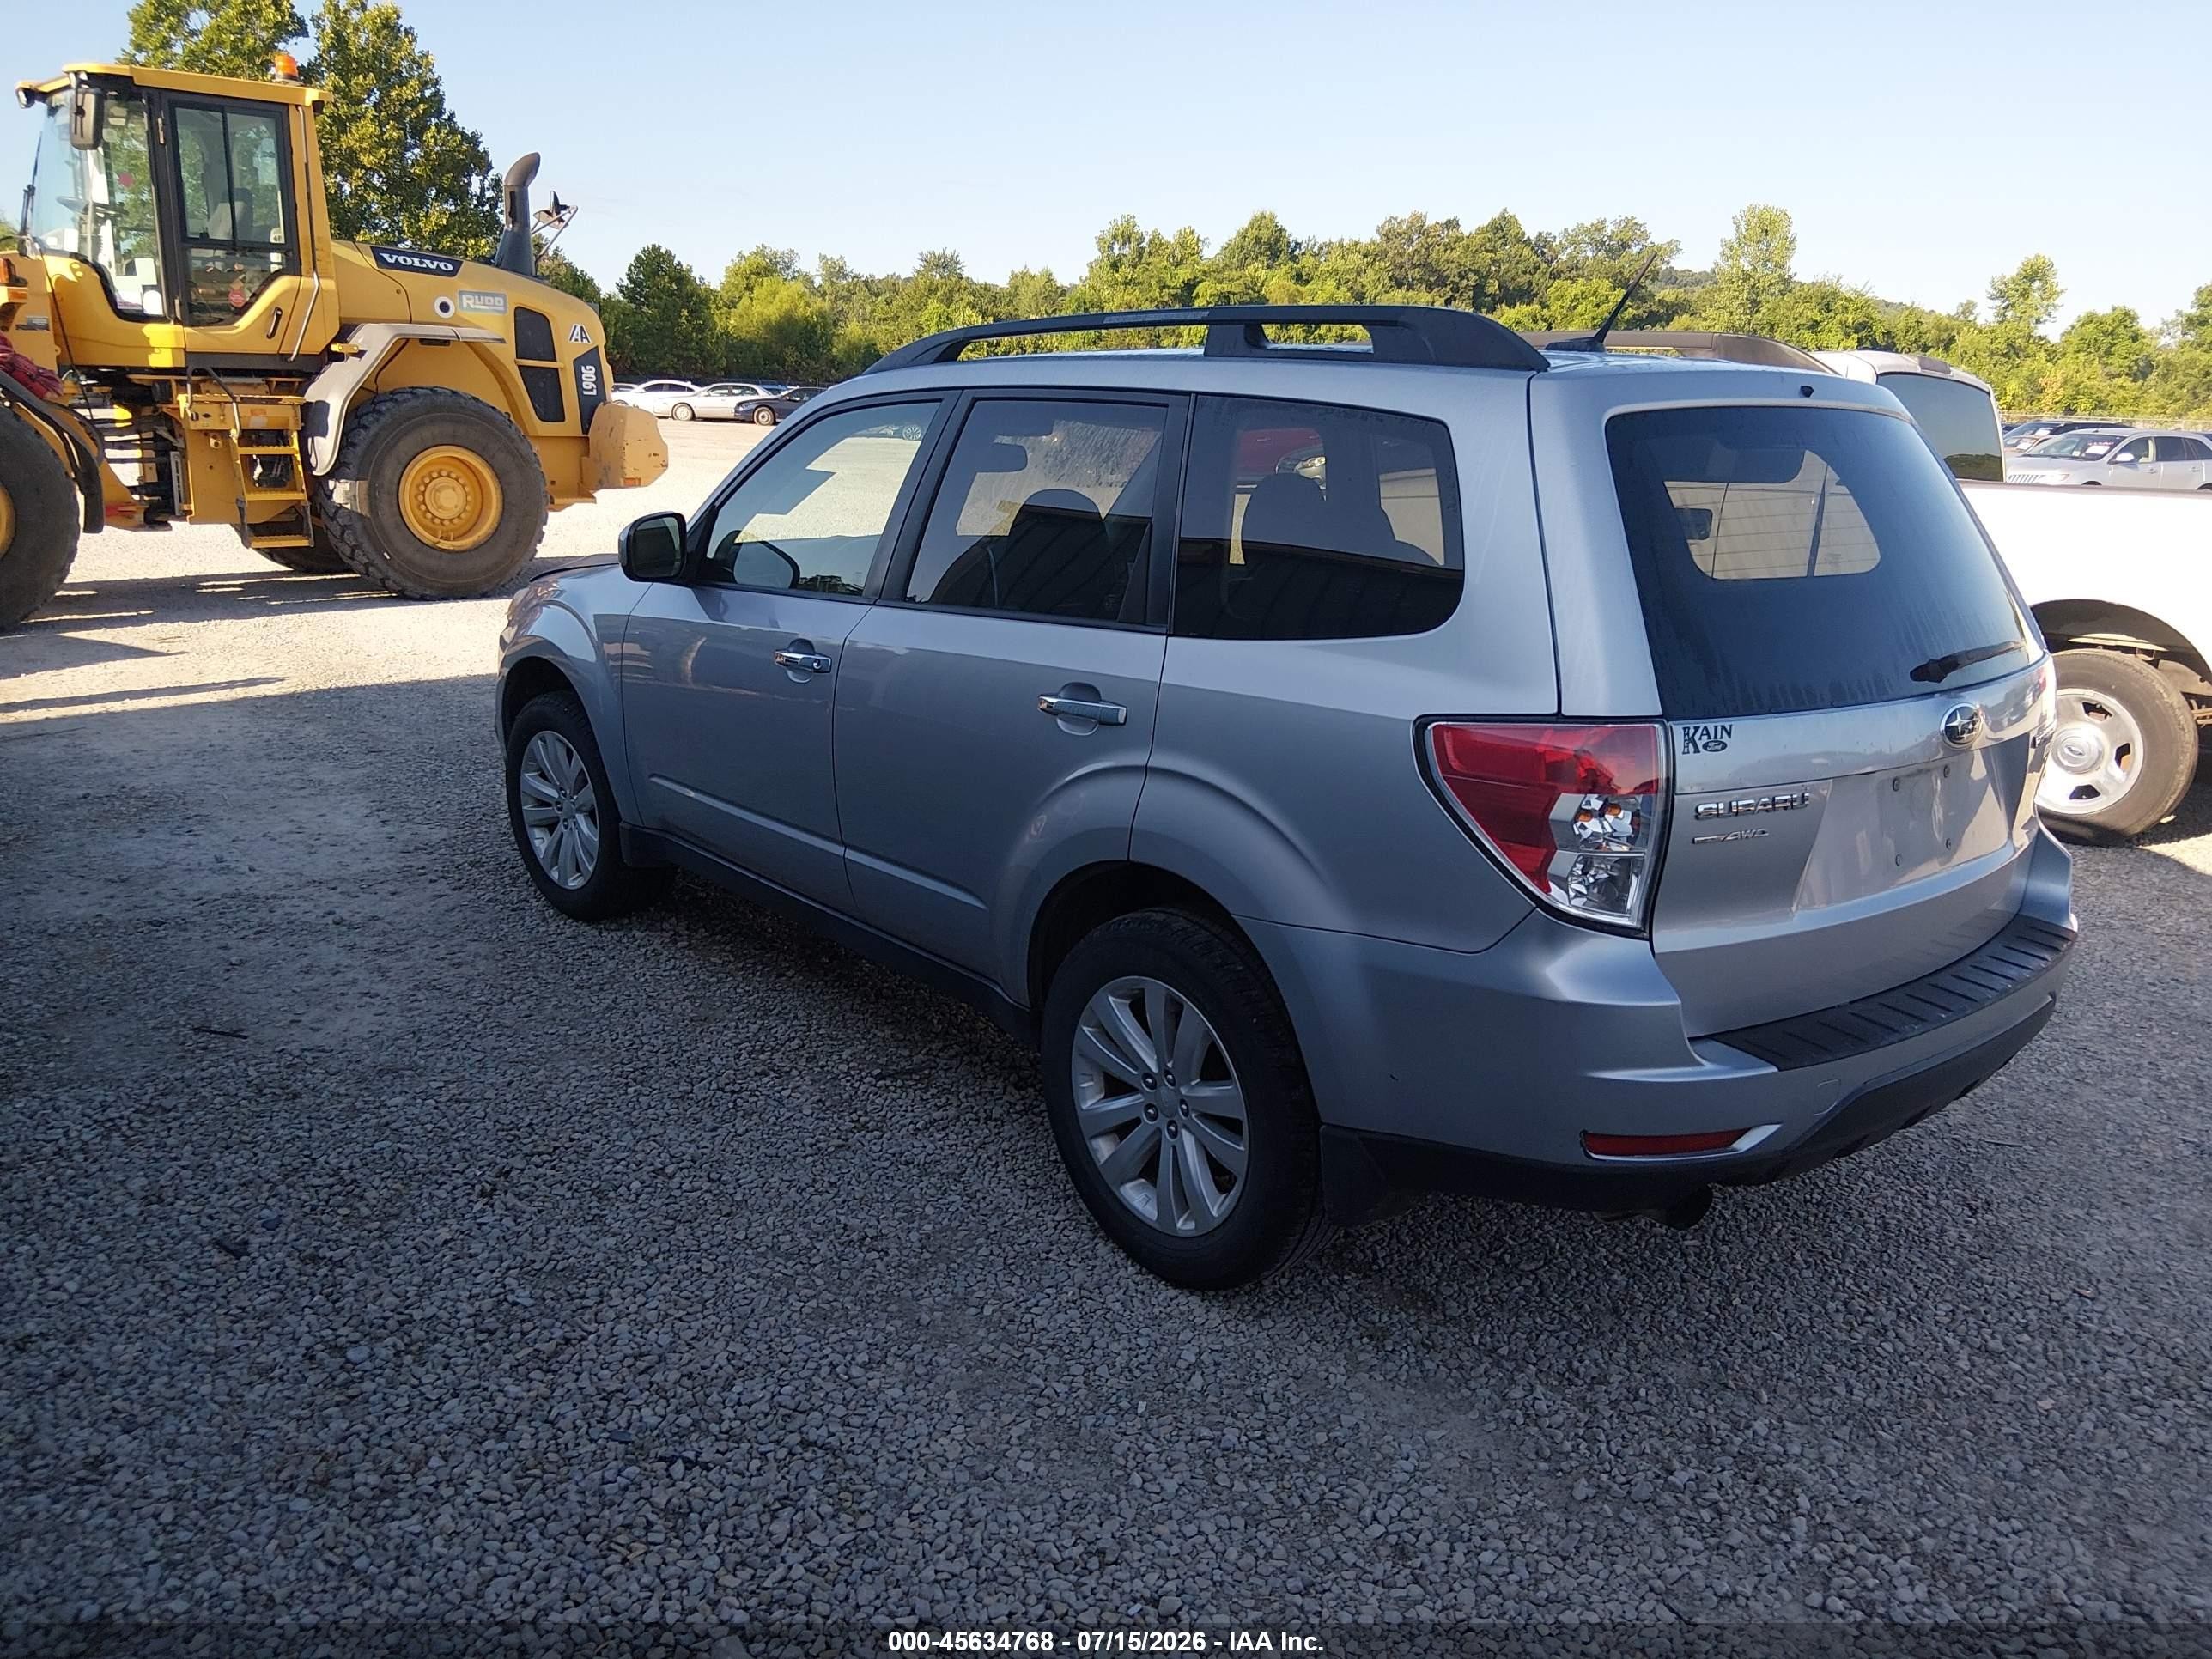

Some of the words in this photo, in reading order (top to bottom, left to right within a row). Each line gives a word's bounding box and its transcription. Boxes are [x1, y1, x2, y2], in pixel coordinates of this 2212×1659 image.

[379, 252, 454, 271] VOLVO
[462, 294, 505, 309] RUDD
[580, 364, 598, 396] L90G
[1682, 724, 1733, 754] KAIN
[1695, 793, 1810, 820] SUBARU
[1723, 828, 1770, 842] AWD
